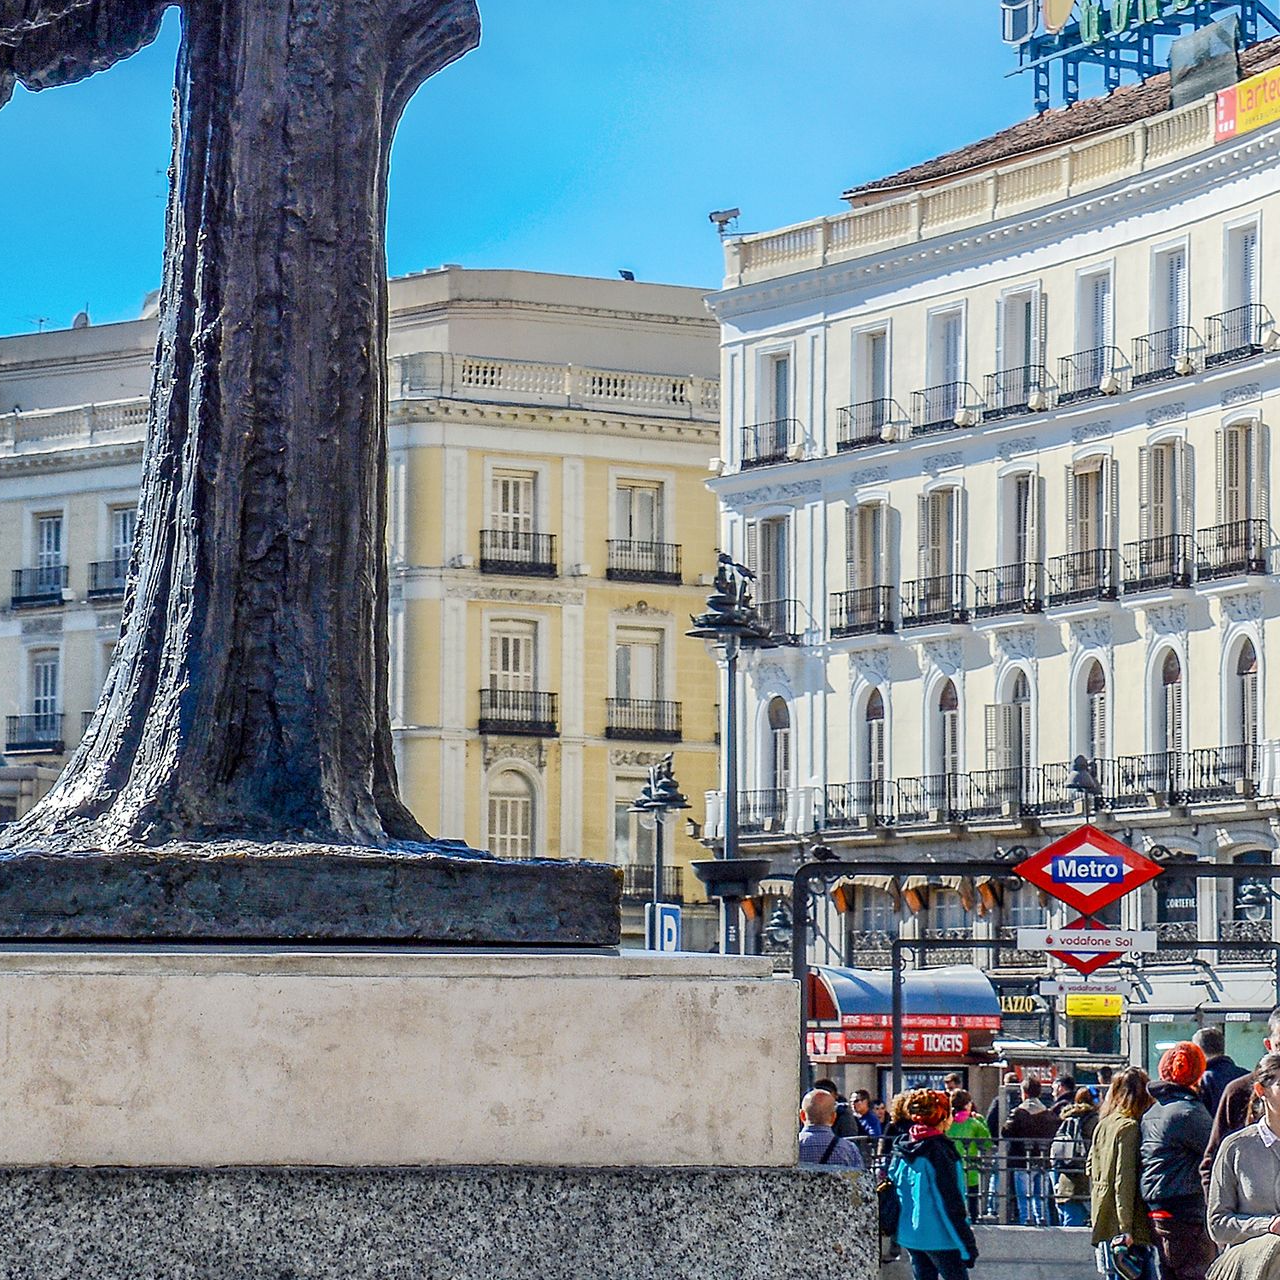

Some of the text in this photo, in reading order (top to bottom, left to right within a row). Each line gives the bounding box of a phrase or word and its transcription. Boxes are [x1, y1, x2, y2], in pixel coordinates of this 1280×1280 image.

[1057, 859, 1118, 878] Metro
[1060, 937, 1133, 947] vodafone Sol
[922, 1034, 963, 1052] TICKETS
